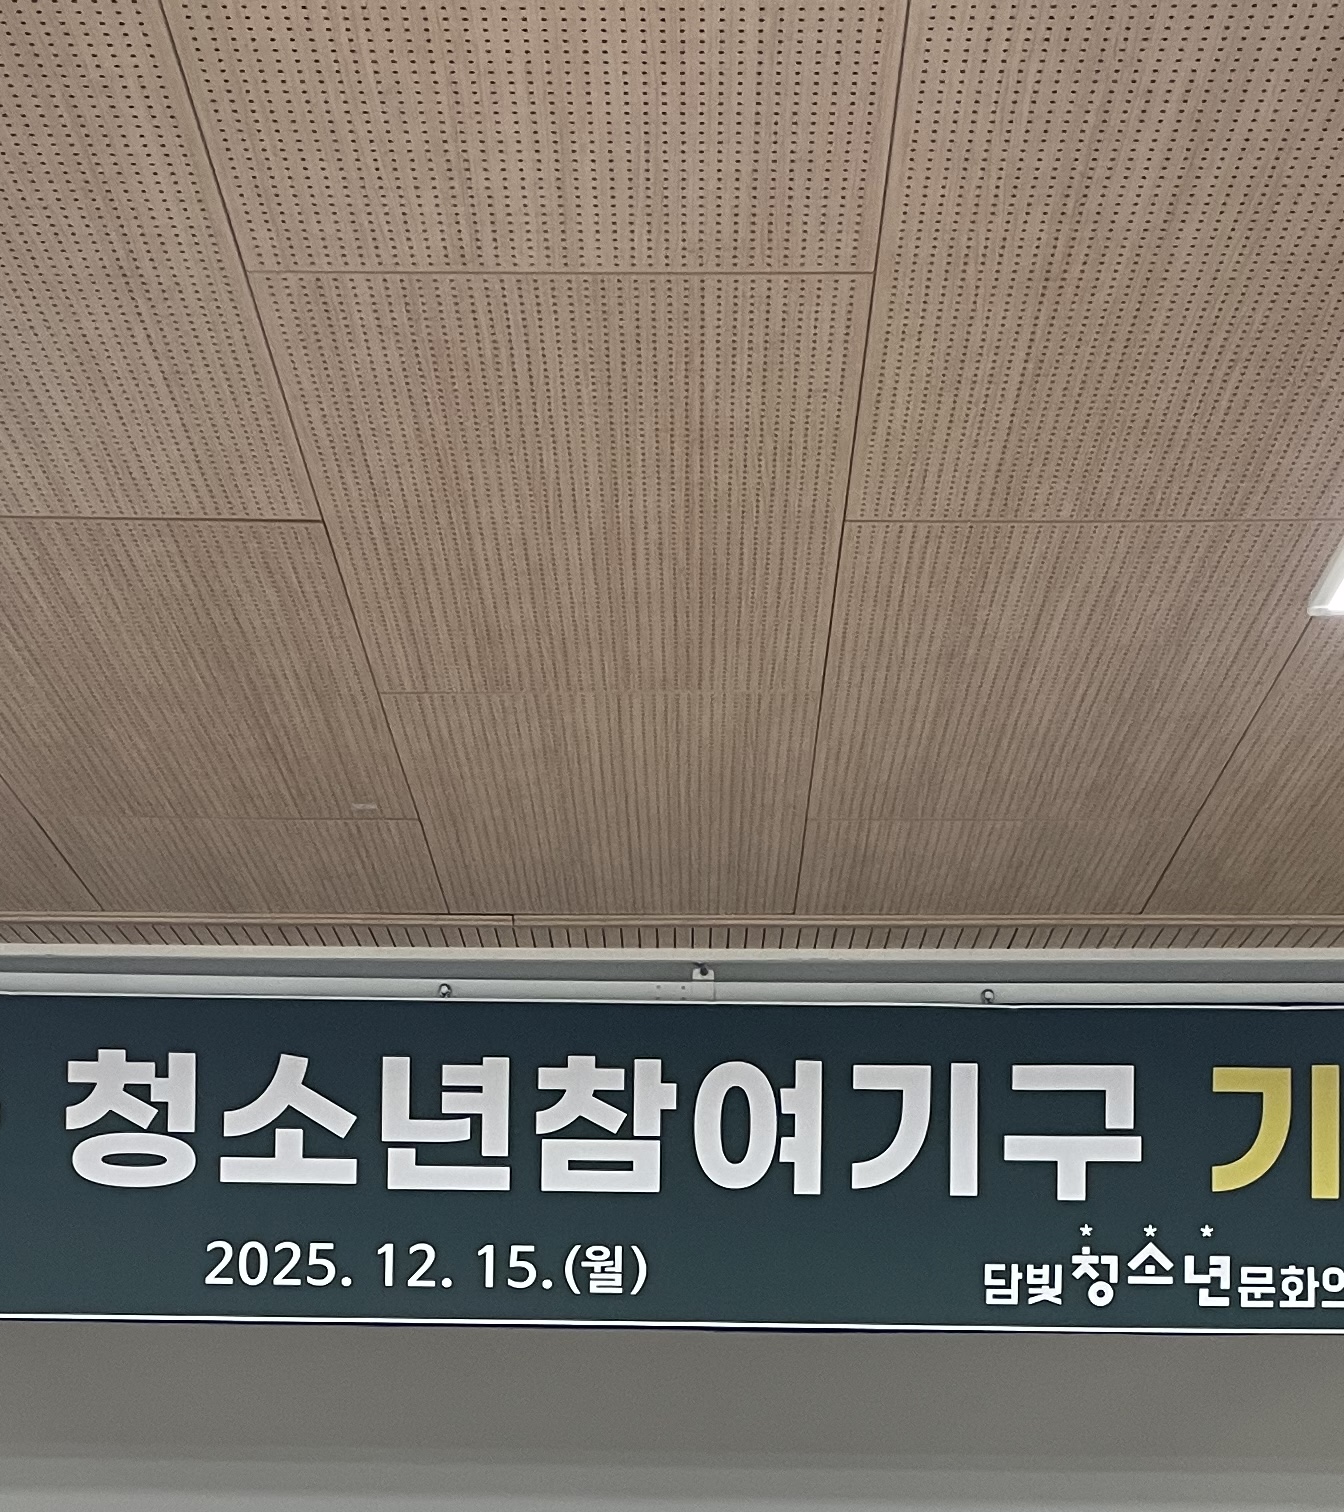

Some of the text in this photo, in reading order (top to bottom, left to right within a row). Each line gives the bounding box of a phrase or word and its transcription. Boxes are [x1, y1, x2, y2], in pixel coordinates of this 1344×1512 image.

[65, 1048, 1143, 1201] 청소년참여기구
[203, 1240, 650, 1296] 2025. 12. 15.(월)
